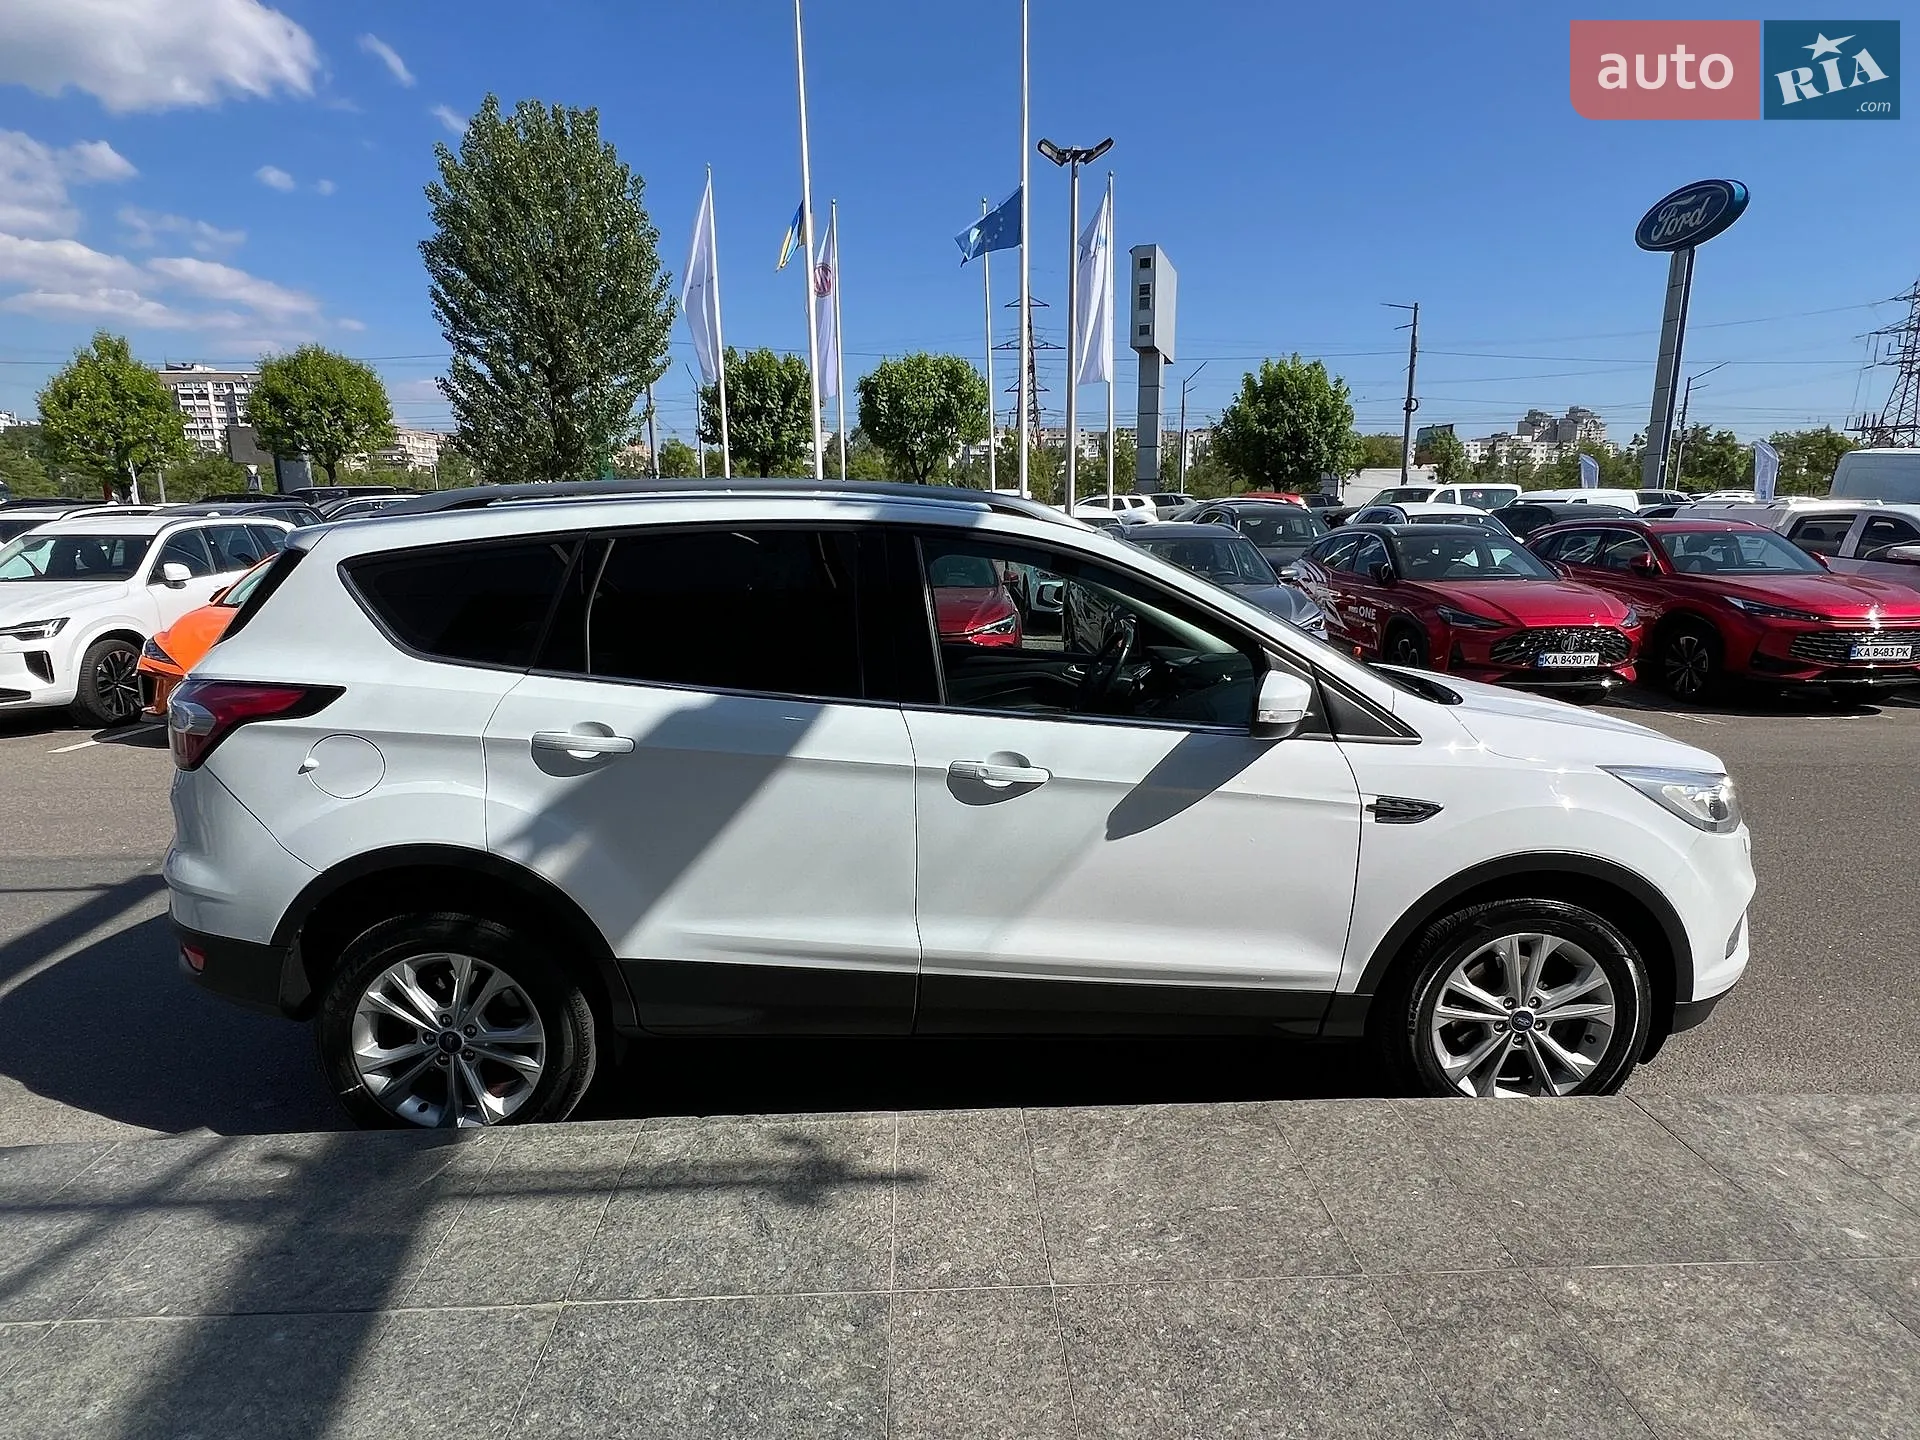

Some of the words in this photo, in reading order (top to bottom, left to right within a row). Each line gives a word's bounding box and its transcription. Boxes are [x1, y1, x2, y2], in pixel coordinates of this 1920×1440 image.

[1651, 194, 1712, 241] Ford
[1358, 606, 1377, 621] ONE
[1857, 648, 1870, 657] KA
[1872, 648, 1895, 657] 8483
[1895, 648, 1910, 657] PK
[1544, 655, 1558, 665] KA
[1560, 655, 1582, 665] 8490
[1583, 655, 1597, 665] PK
